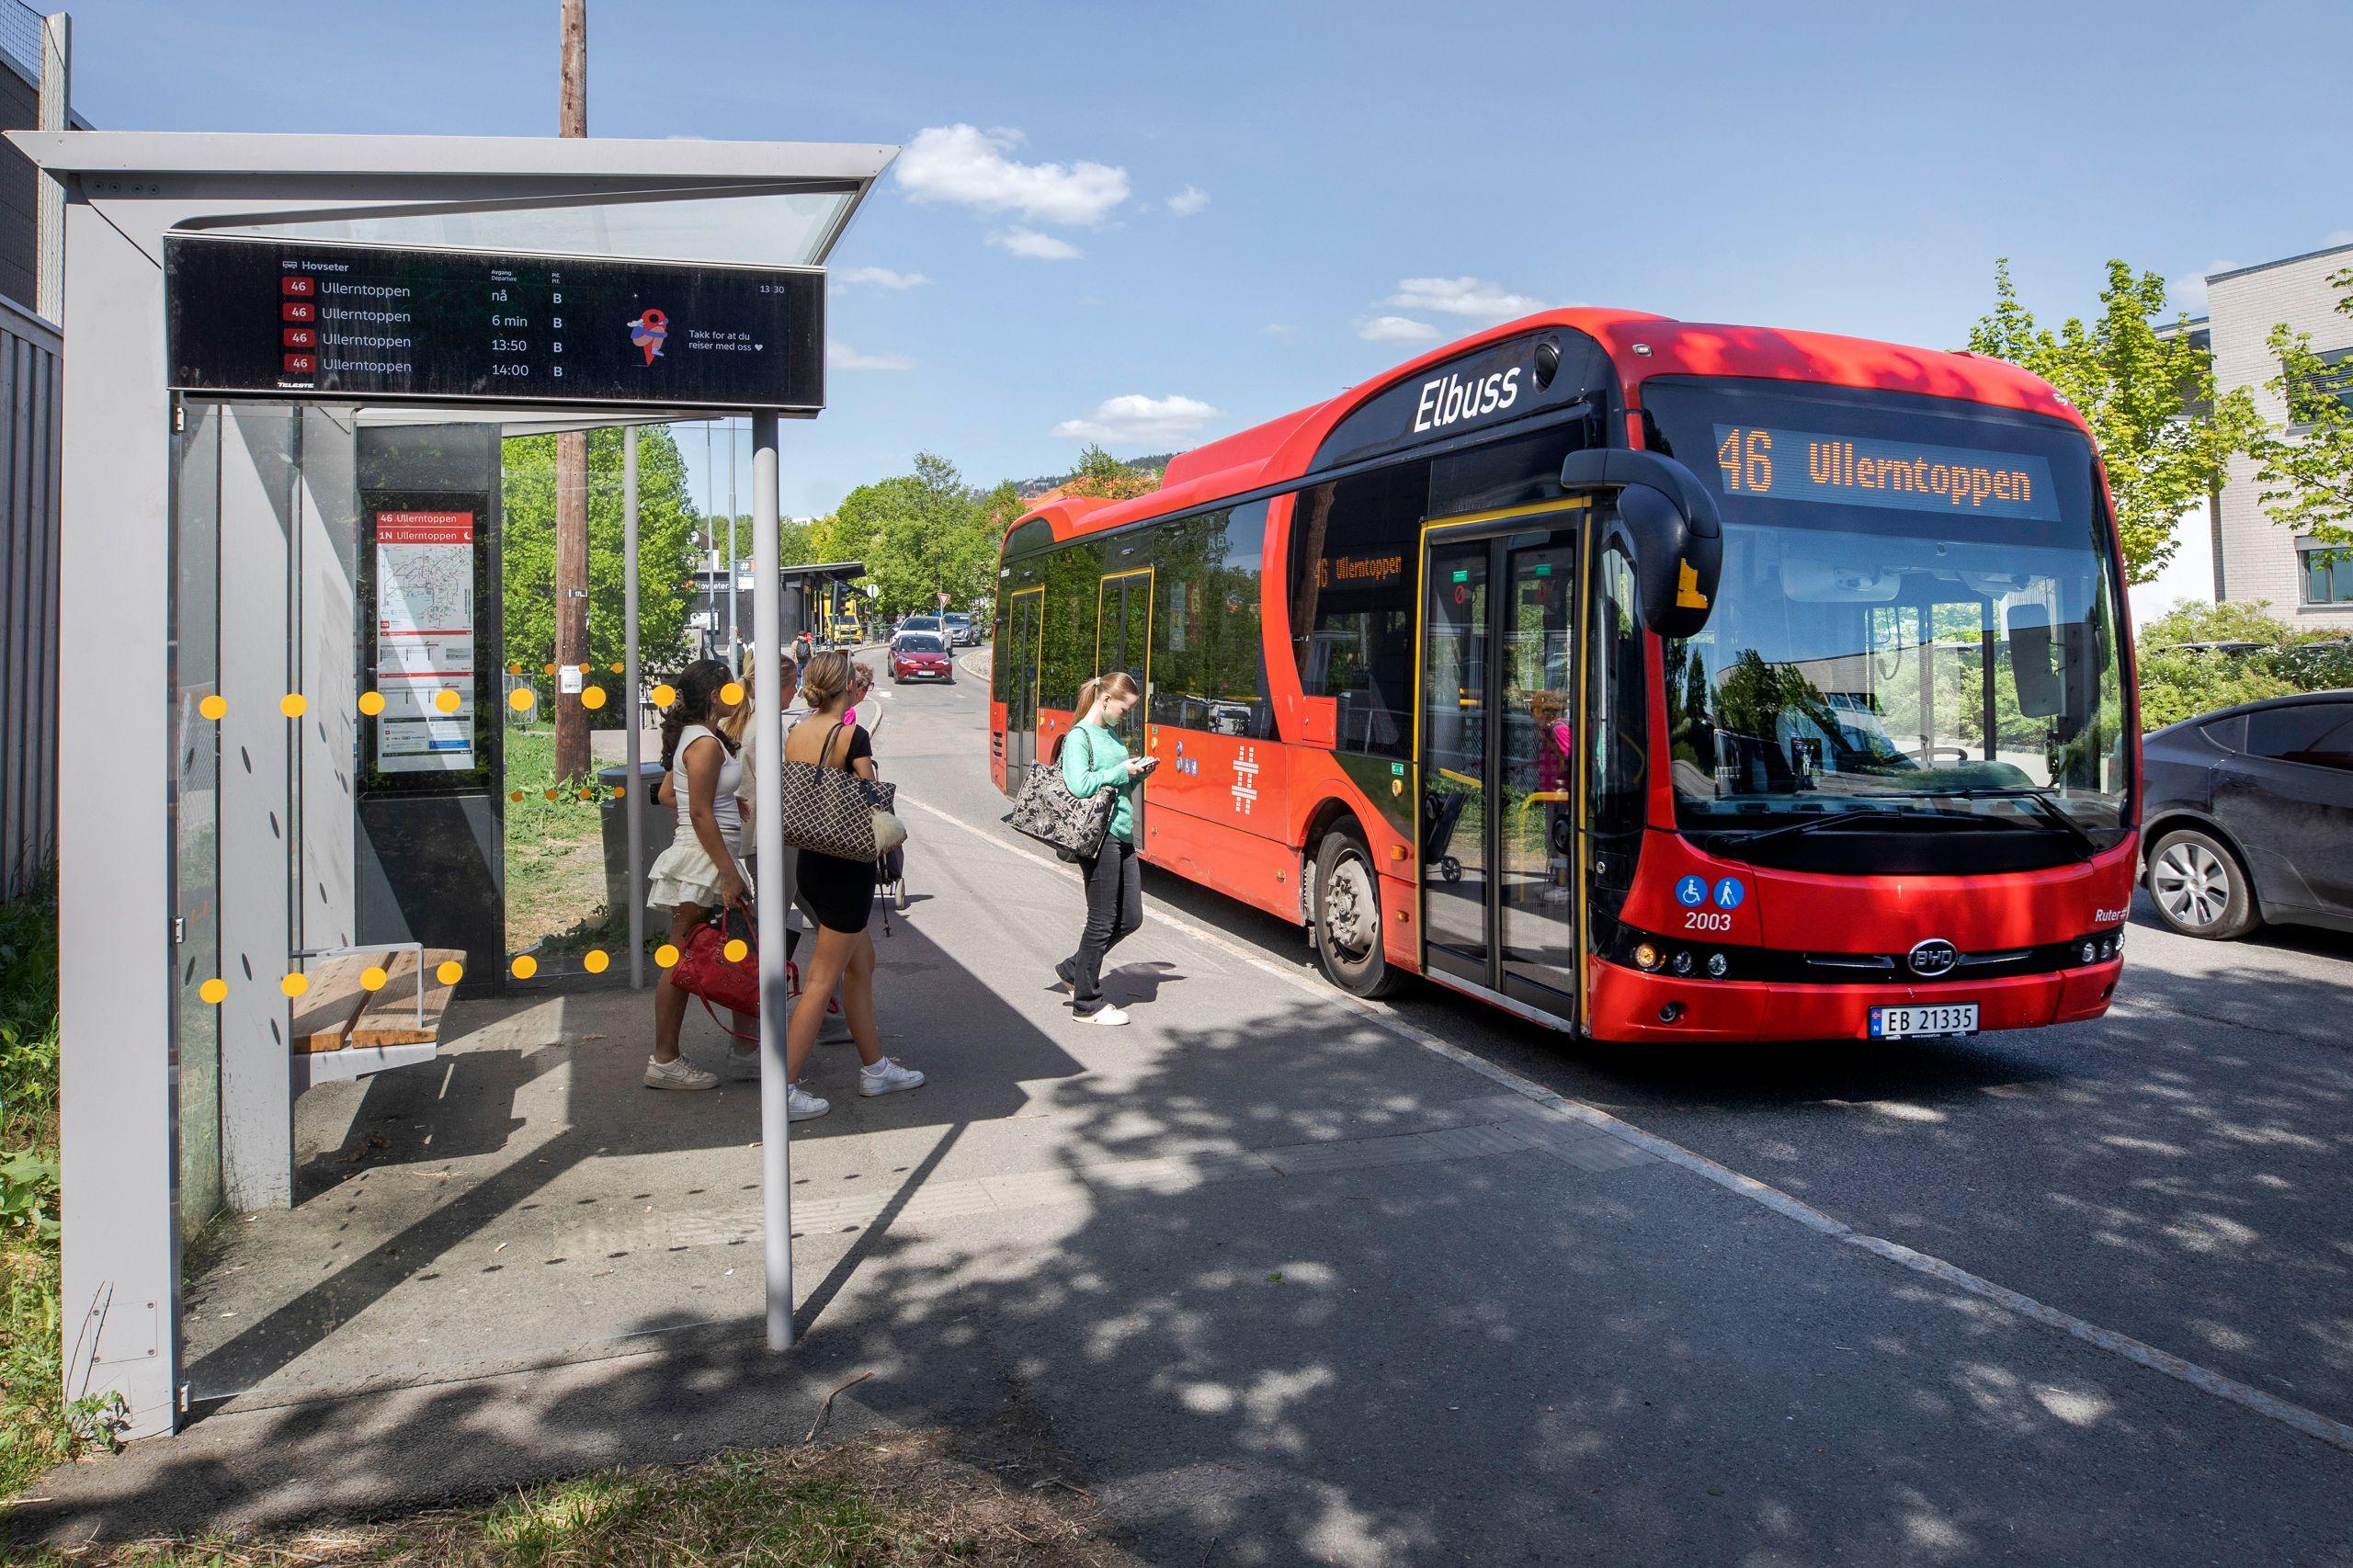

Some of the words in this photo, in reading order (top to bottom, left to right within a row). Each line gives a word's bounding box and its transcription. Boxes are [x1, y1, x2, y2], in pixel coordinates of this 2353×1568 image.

[301, 261, 349, 272] Hovseter
[290, 281, 306, 291] 46
[322, 282, 411, 298] Ullerntoppen
[492, 289, 507, 301] nå
[552, 293, 563, 304] B
[291, 307, 307, 317] 46
[322, 308, 411, 324] Ullerntoppen
[492, 314, 500, 326] 6
[505, 315, 528, 327] min
[553, 317, 563, 328] B
[292, 333, 308, 343] 46
[323, 334, 411, 349] Ullerntoppen
[492, 339, 527, 351] 13:50
[553, 342, 563, 353] B
[688, 330, 710, 339] Takk
[712, 331, 725, 340] for
[726, 332, 737, 340] at
[738, 332, 750, 341] du
[688, 341, 713, 350] reiser
[715, 342, 735, 350] med
[292, 358, 308, 369] 46
[324, 358, 412, 374] Ullerntoppen
[492, 364, 529, 376] 14:00
[553, 366, 563, 377] B
[1413, 367, 1522, 434] Elbuss
[1717, 427, 1773, 493] 46
[1809, 440, 2031, 507] Ullerntoppen
[381, 514, 393, 523] 46
[396, 514, 457, 524] Ullerntoppen
[379, 531, 393, 540] 1N
[396, 531, 457, 541] Ullerntoppen
[1336, 556, 1402, 581] Ullerntoppen
[695, 581, 729, 590] Hoveter
[1684, 911, 1732, 931] 2003
[1915, 950, 1952, 966] BYD
[1889, 1011, 1910, 1031] EB
[1918, 1007, 1972, 1030] 21335
